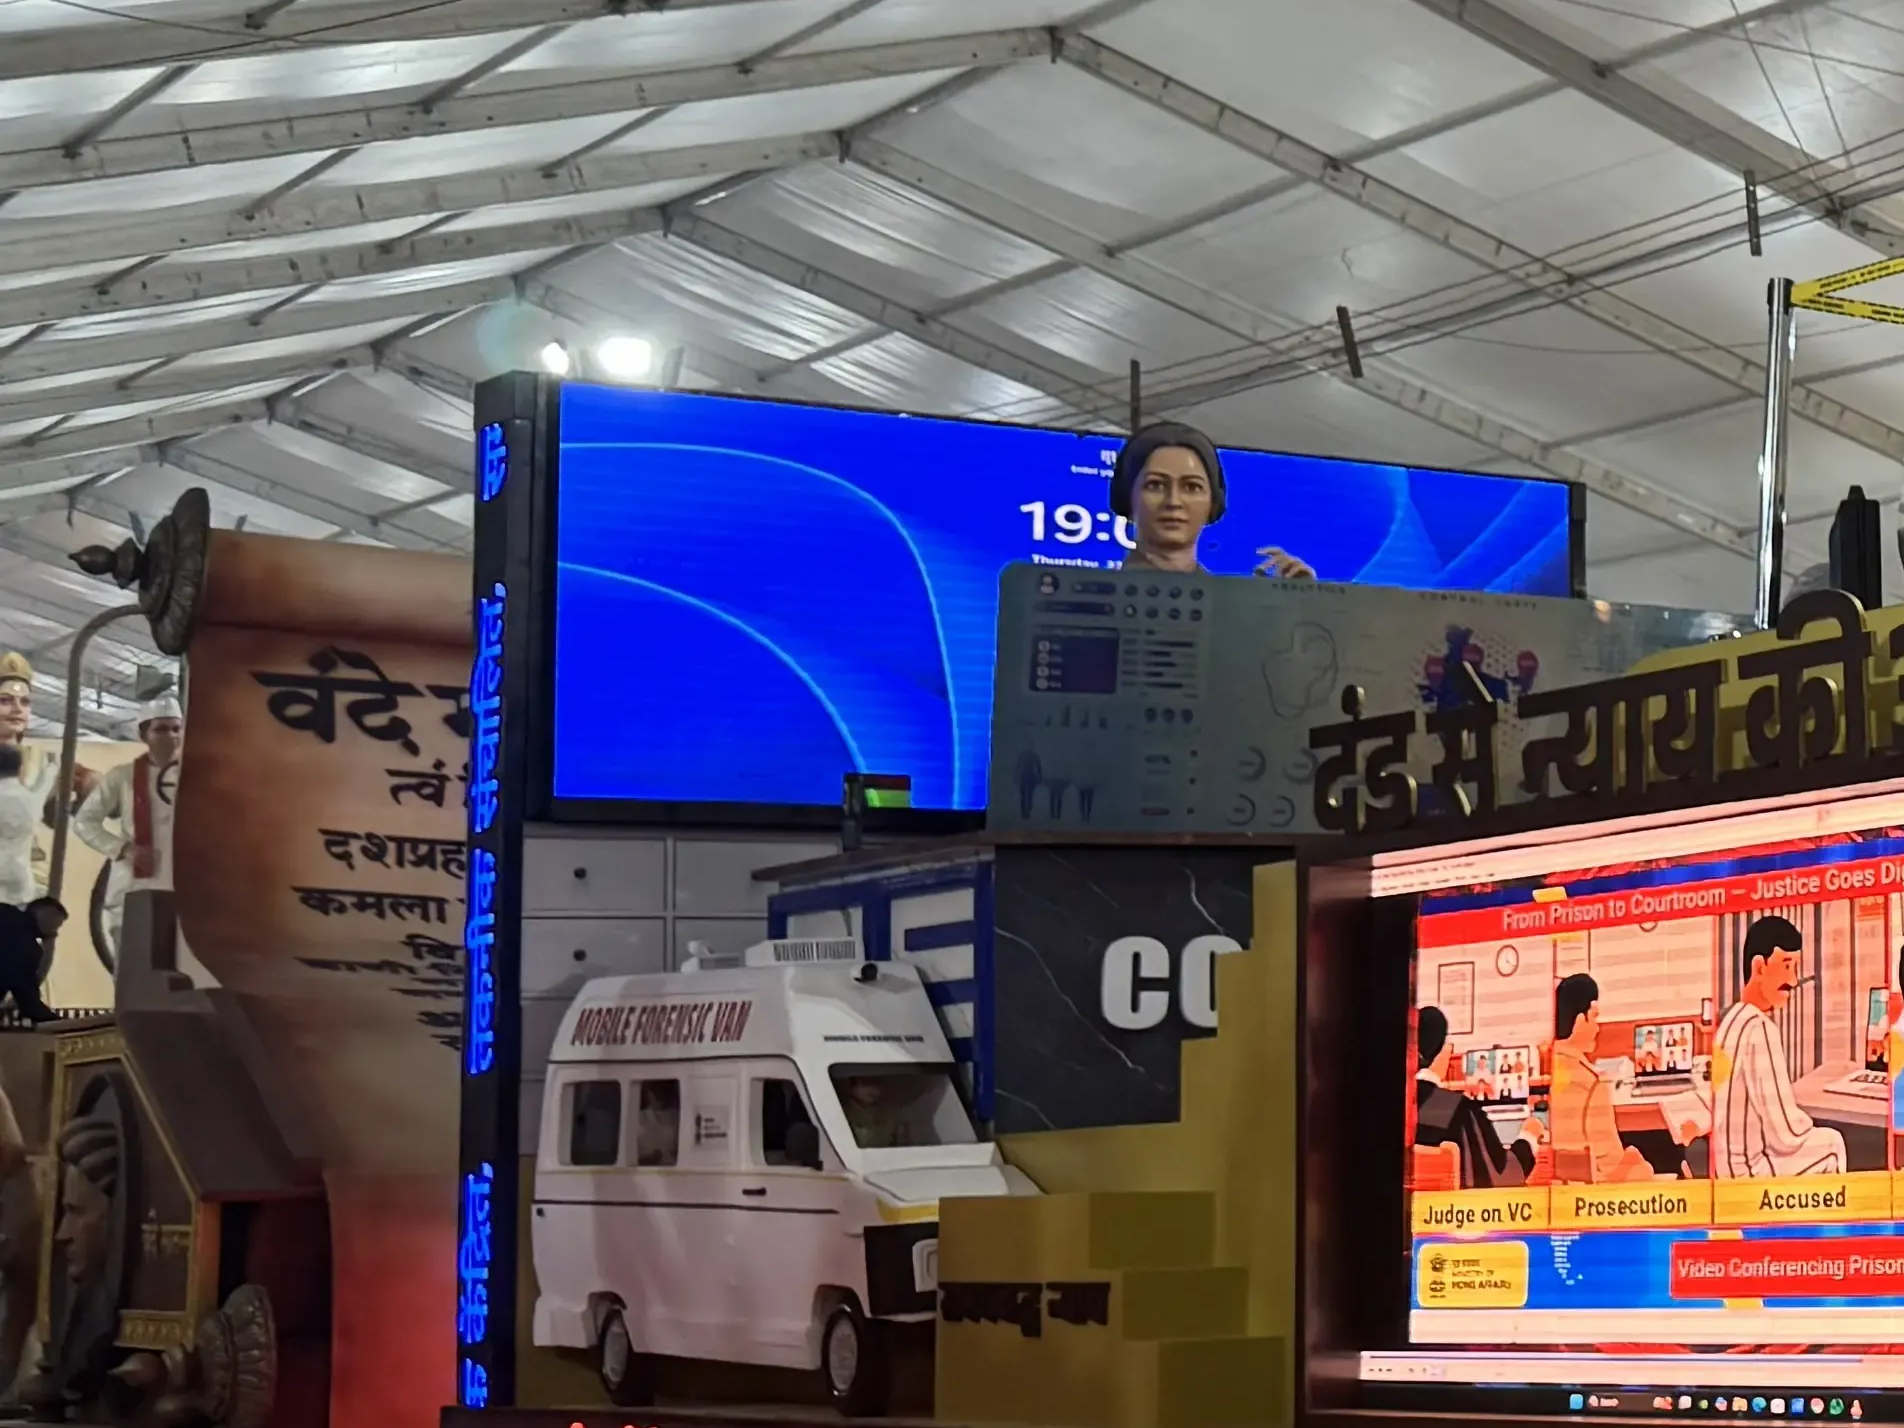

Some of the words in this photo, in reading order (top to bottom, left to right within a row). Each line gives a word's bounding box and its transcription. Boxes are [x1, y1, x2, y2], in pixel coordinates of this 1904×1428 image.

[249, 645, 426, 756] वंदे
[1310, 684, 1418, 834] दंड
[1426, 661, 1500, 816] से
[1518, 660, 1727, 800] न्याय
[1737, 588, 1876, 769] की
[289, 885, 449, 925] कमला
[1502, 908, 1546, 932] From
[1549, 902, 1605, 927] Prison
[1608, 899, 1626, 918] to
[1630, 887, 1726, 916] Courtroom
[1749, 873, 1821, 902] Justice
[1825, 866, 1876, 890] Goes
[569, 1005, 636, 1047] MOBILE
[631, 1001, 715, 1045] FORENSIC
[711, 1000, 754, 1043] VAN
[1423, 1203, 1476, 1229] Judge
[1481, 1207, 1504, 1224] on
[1507, 1202, 1534, 1223] VC
[1574, 1193, 1688, 1218] Prosecution
[1758, 1184, 1848, 1212] Accused
[1676, 1257, 1727, 1279] Video
[1727, 1256, 1845, 1282] Conferencing
